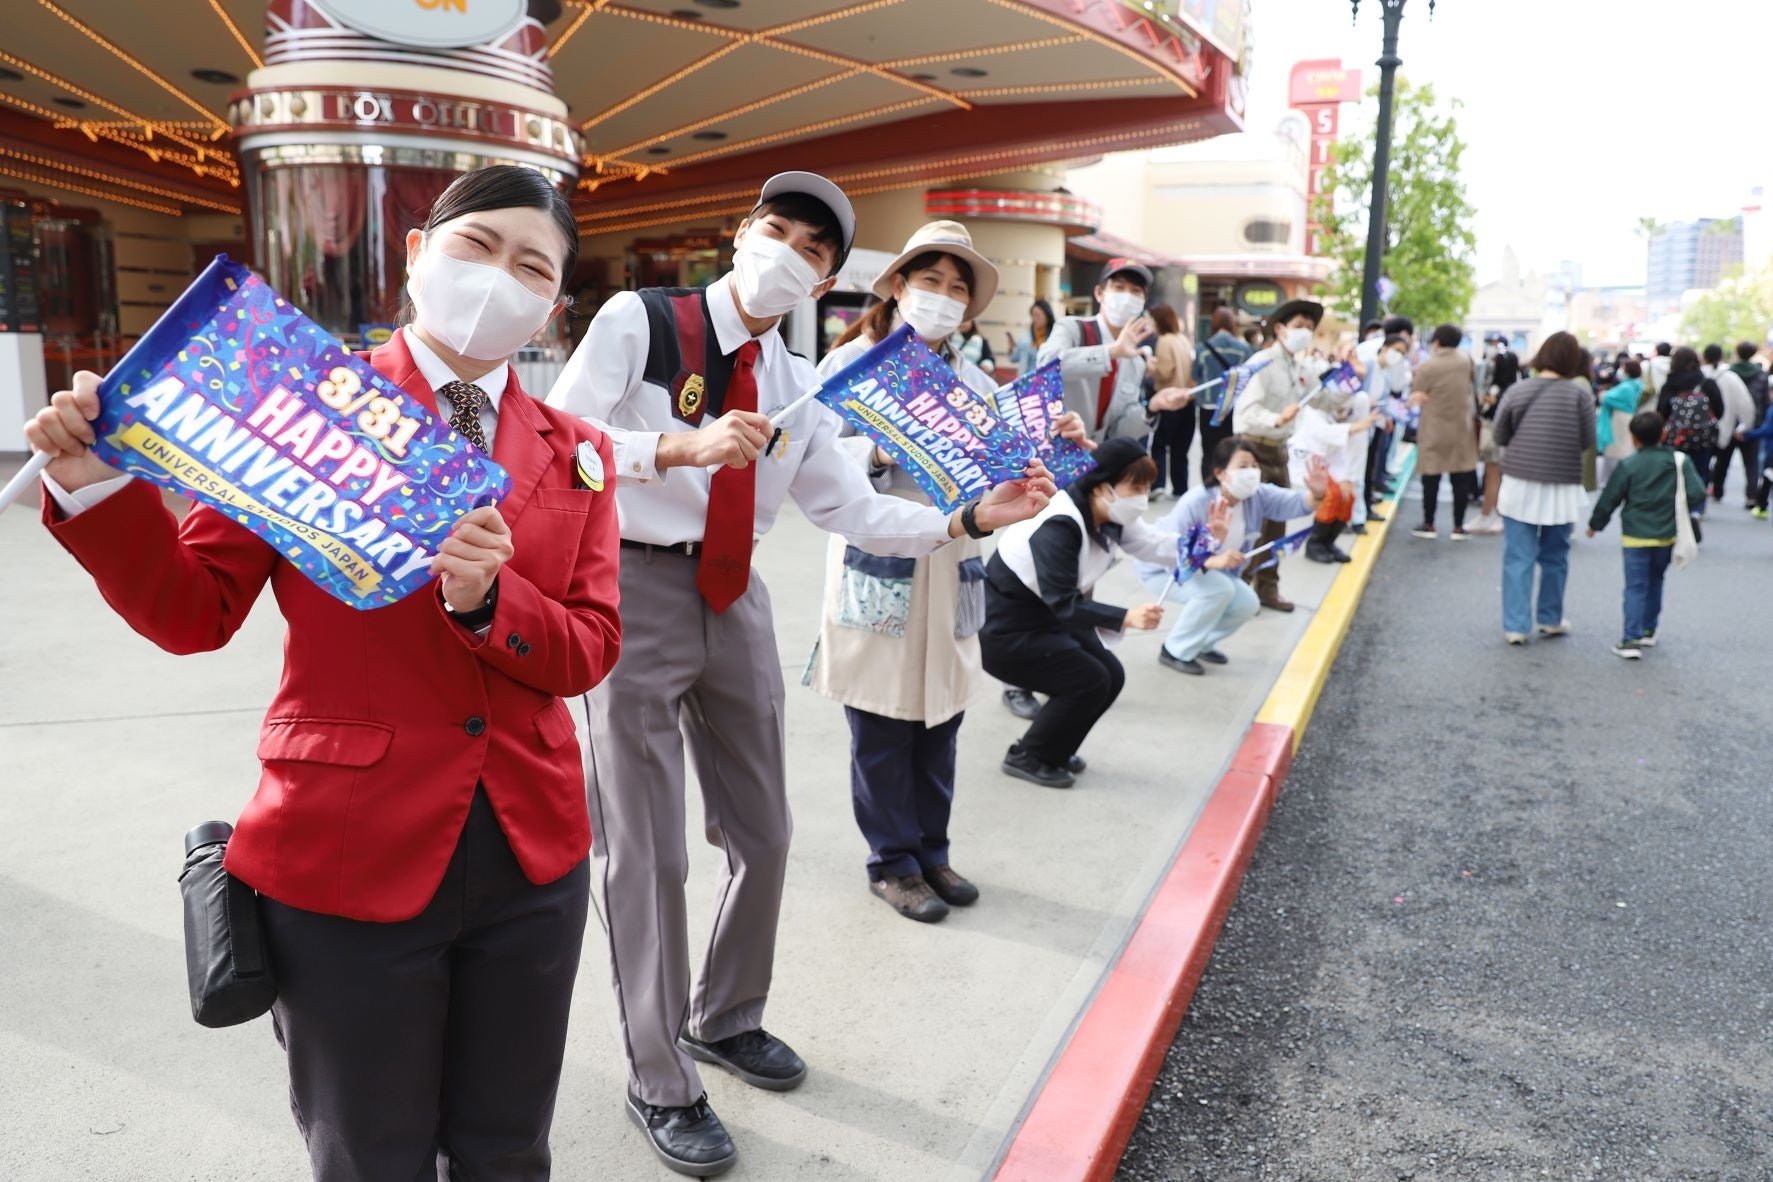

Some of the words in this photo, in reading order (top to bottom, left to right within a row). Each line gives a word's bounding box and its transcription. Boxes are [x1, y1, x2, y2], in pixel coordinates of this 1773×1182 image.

[245, 385, 411, 506] HAPPY
[317, 366, 421, 458] 3/31
[849, 378, 992, 493] ANNIVERSARY
[857, 405, 901, 441] UNIVERSAL
[902, 441, 934, 470] STUDIOS
[932, 467, 954, 493] JAPAN
[905, 391, 989, 452] HAPPY
[946, 386, 996, 435] 3/31
[1019, 394, 1054, 451] HAPPY
[125, 375, 435, 581] ANNIVERSARY
[142, 438, 237, 503] UNIVERSAL
[246, 504, 320, 540] STUDIOS
[321, 541, 370, 581] JAPAN
